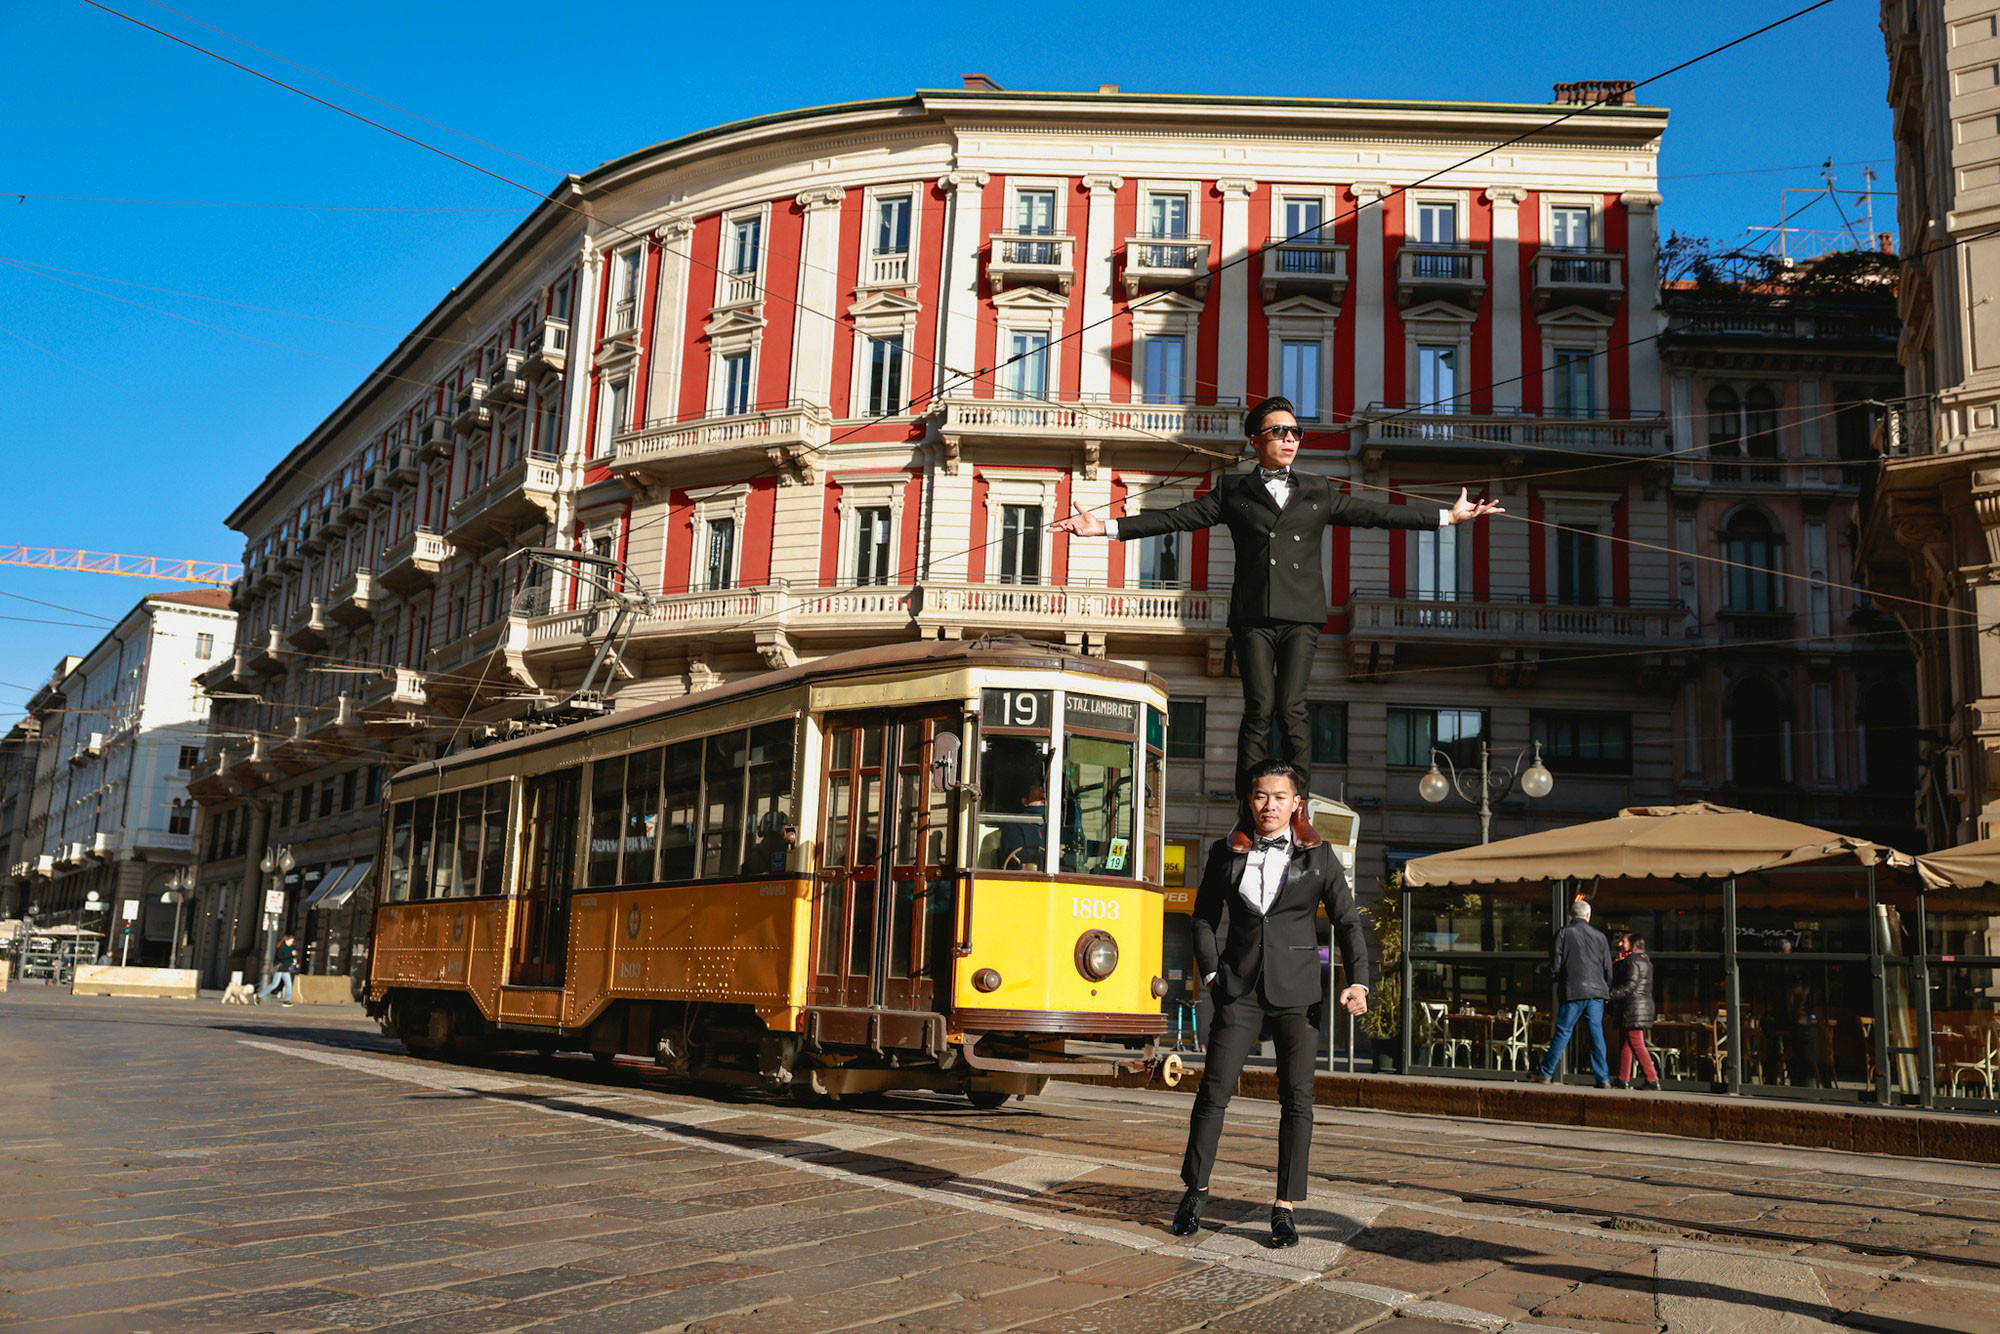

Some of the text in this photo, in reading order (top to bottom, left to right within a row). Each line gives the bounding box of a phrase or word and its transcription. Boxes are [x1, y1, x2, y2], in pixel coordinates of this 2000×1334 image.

[1003, 692, 1038, 725] 19
[1091, 701, 1133, 718] LAMBRATE
[1112, 845, 1123, 856] 41
[1110, 857, 1121, 868] 19
[1072, 897, 1120, 920] 1803
[620, 962, 641, 979] 1803
